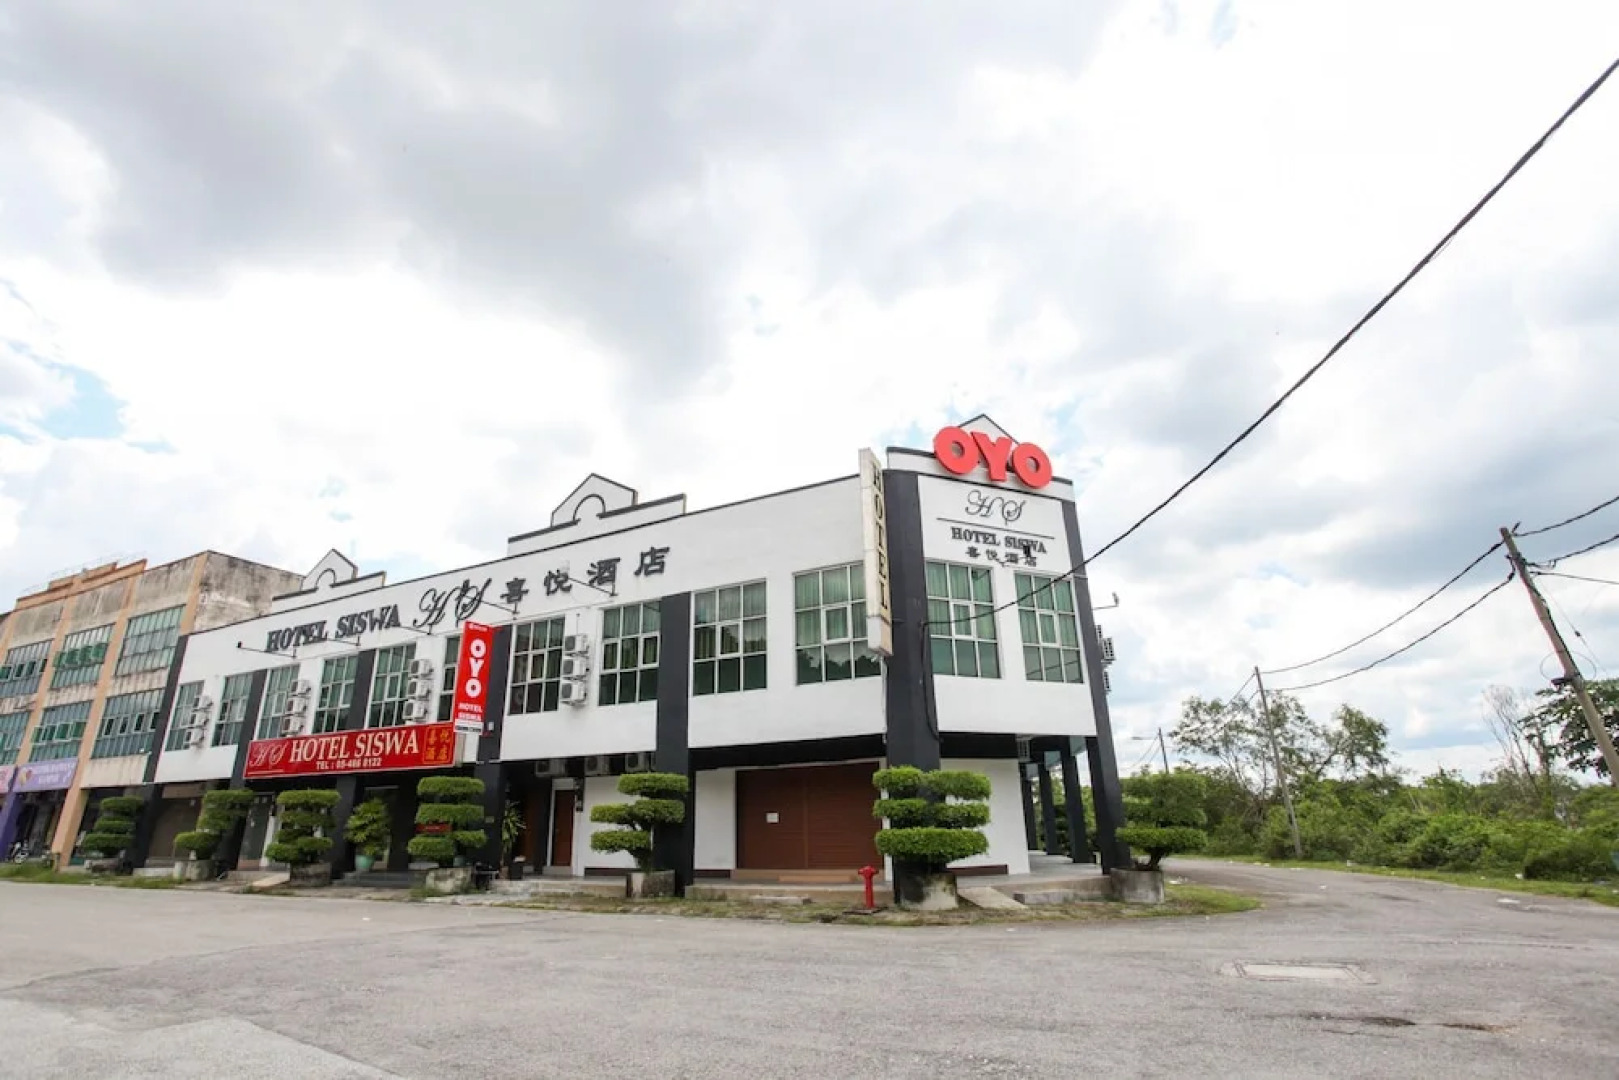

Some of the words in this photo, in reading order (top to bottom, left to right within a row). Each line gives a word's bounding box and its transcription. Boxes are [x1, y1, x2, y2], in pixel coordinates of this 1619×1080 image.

[933, 426, 1053, 489] OYO
[872, 464, 888, 610] HOTEL
[950, 526, 1000, 547] HOTEL
[1004, 535, 1047, 554] SISWA
[500, 546, 670, 604] 喜悦酒店
[266, 620, 328, 651] HOTEL
[335, 604, 400, 639] SISWA
[465, 637, 487, 698] OYO
[289, 735, 350, 762] HOTEL
[354, 729, 419, 757] SISWA
